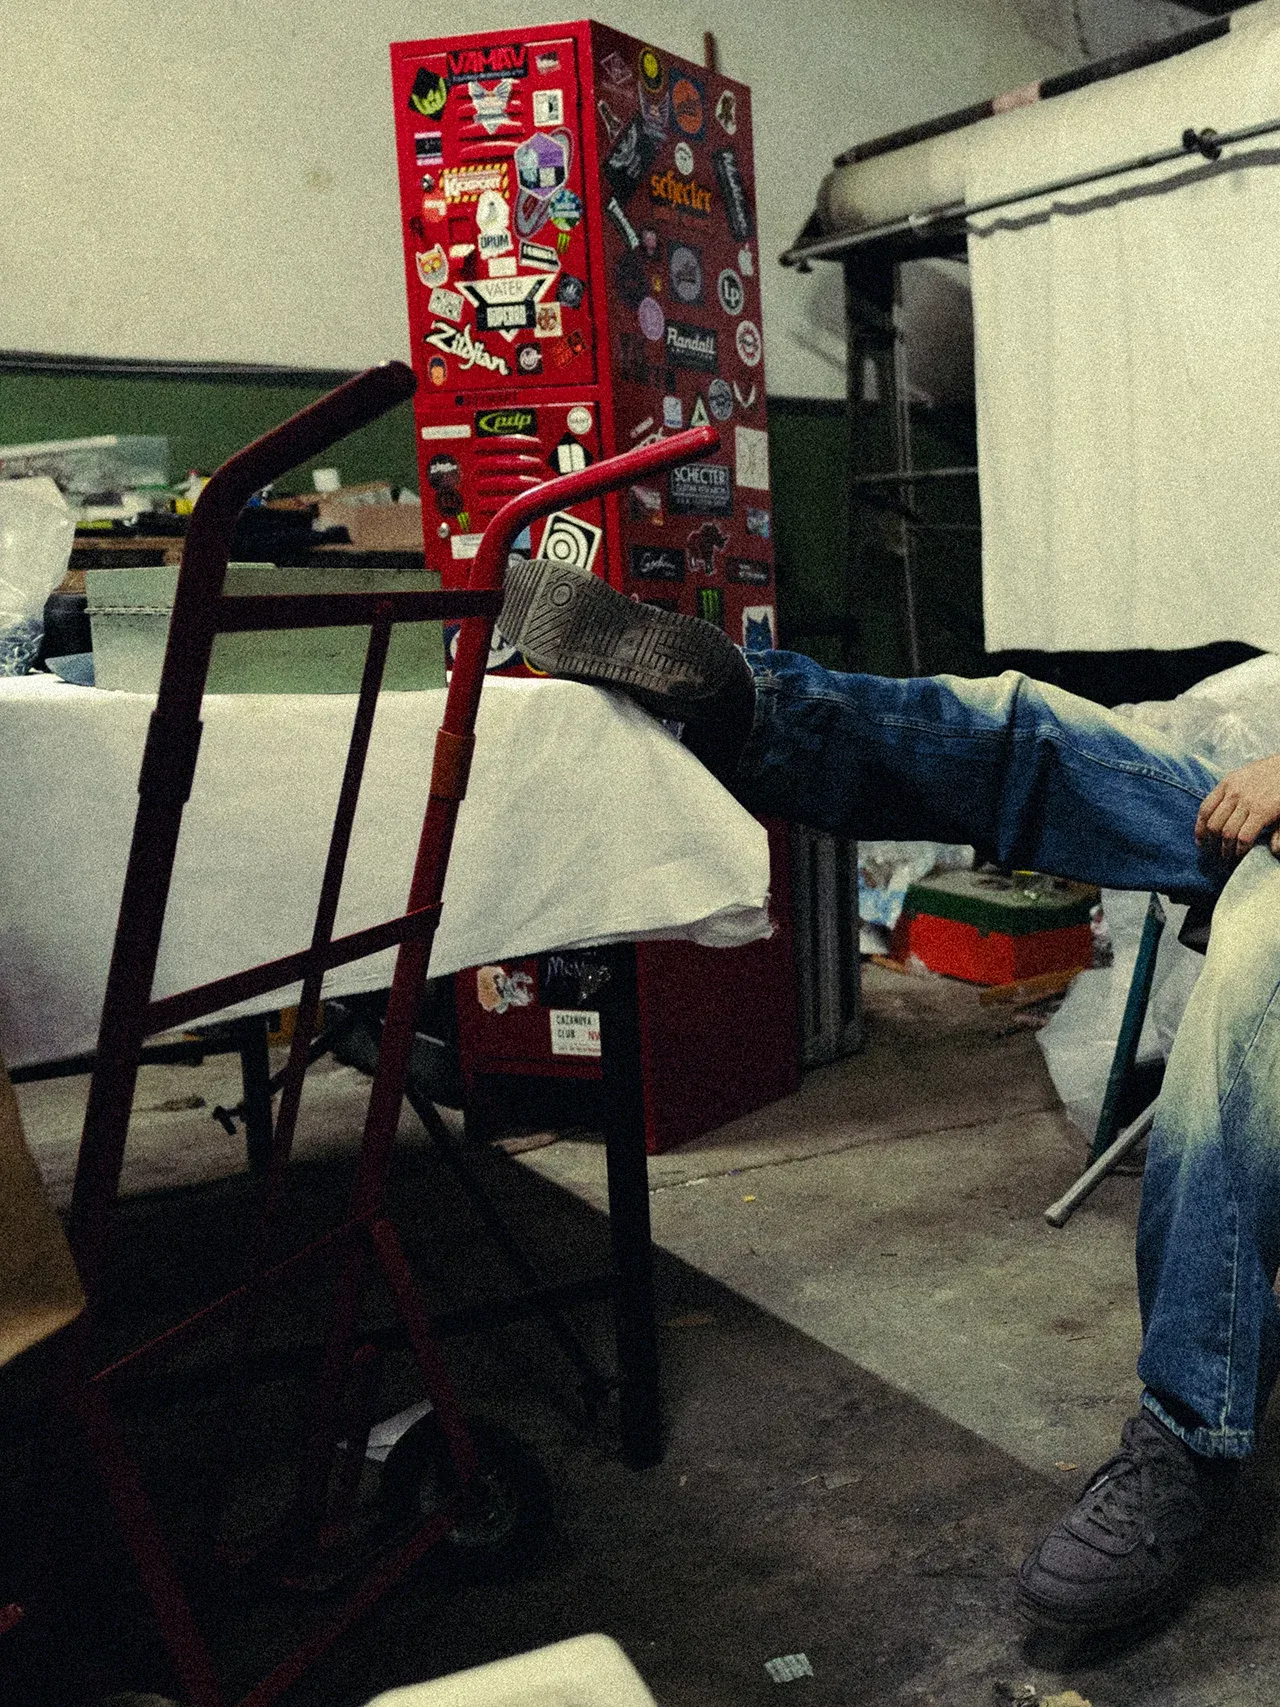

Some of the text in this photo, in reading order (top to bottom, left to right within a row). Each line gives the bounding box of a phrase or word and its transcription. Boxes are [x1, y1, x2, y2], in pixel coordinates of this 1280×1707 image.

[485, 280, 524, 296] VATER
[425, 321, 510, 376] Zildjian
[666, 326, 716, 355] Randall
[673, 466, 727, 485] SCHECTER
[557, 1028, 576, 1039] CLUB
